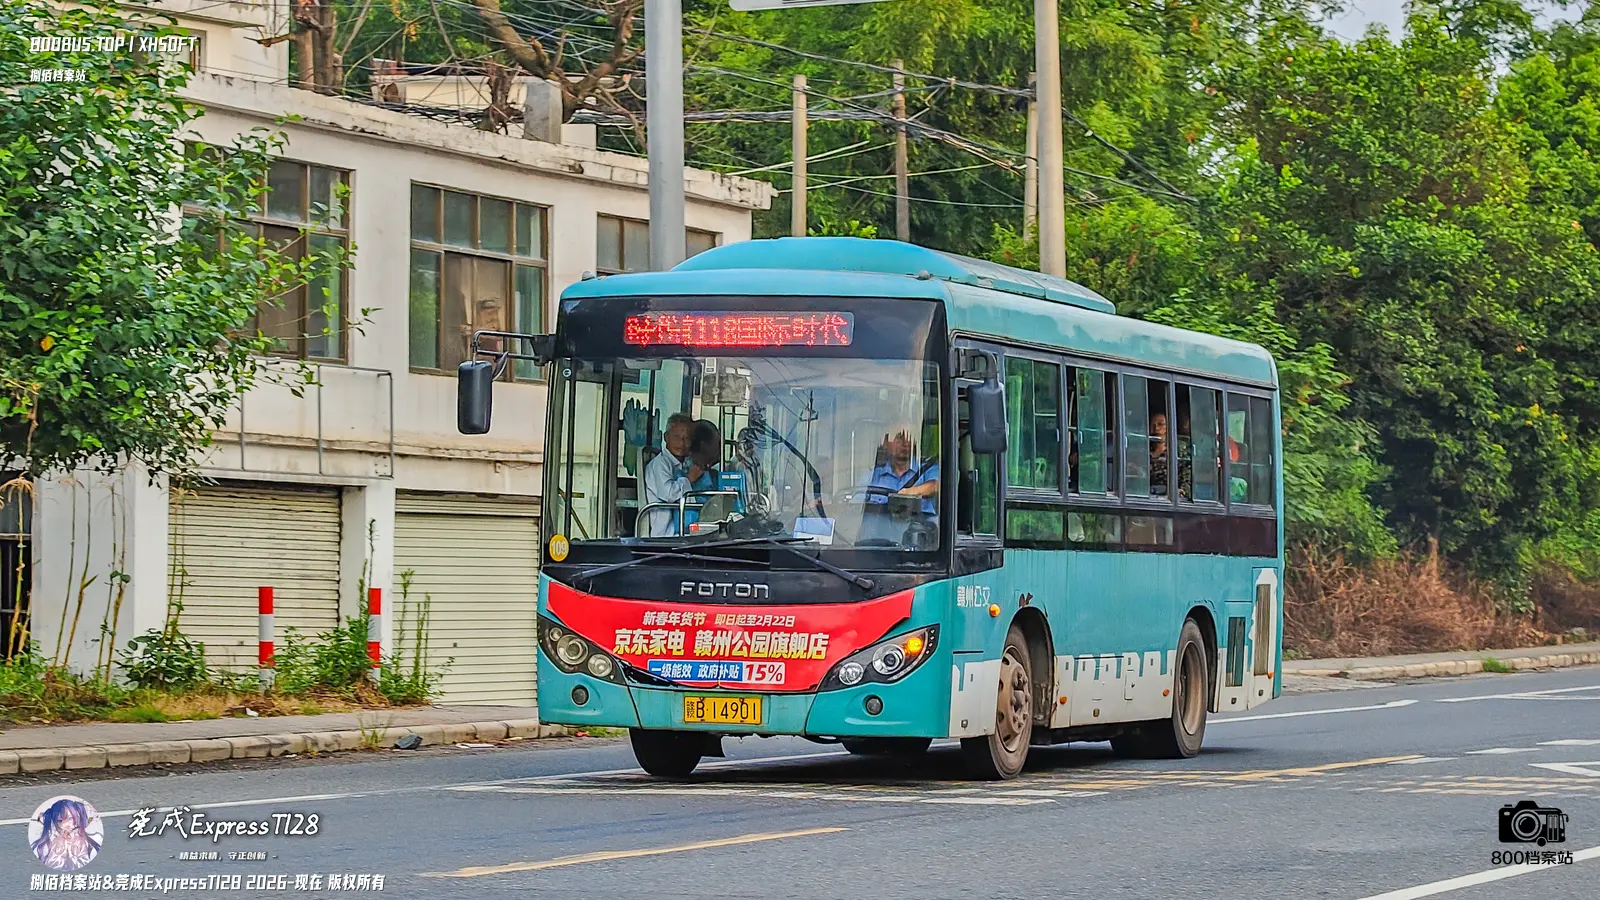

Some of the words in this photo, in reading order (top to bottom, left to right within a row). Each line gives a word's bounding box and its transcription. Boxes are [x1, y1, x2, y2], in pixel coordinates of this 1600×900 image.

[551, 540, 567, 556] 109
[680, 581, 769, 599] FOTON
[642, 611, 707, 627] 新春年货节
[714, 613, 796, 628] 即日起至2月22日
[612, 628, 686, 656] 京东家电
[693, 629, 830, 660] 赣州公园旗舰店
[651, 663, 692, 679] 一级能效
[697, 664, 740, 680] 政府补贴
[745, 663, 784, 682] 15%
